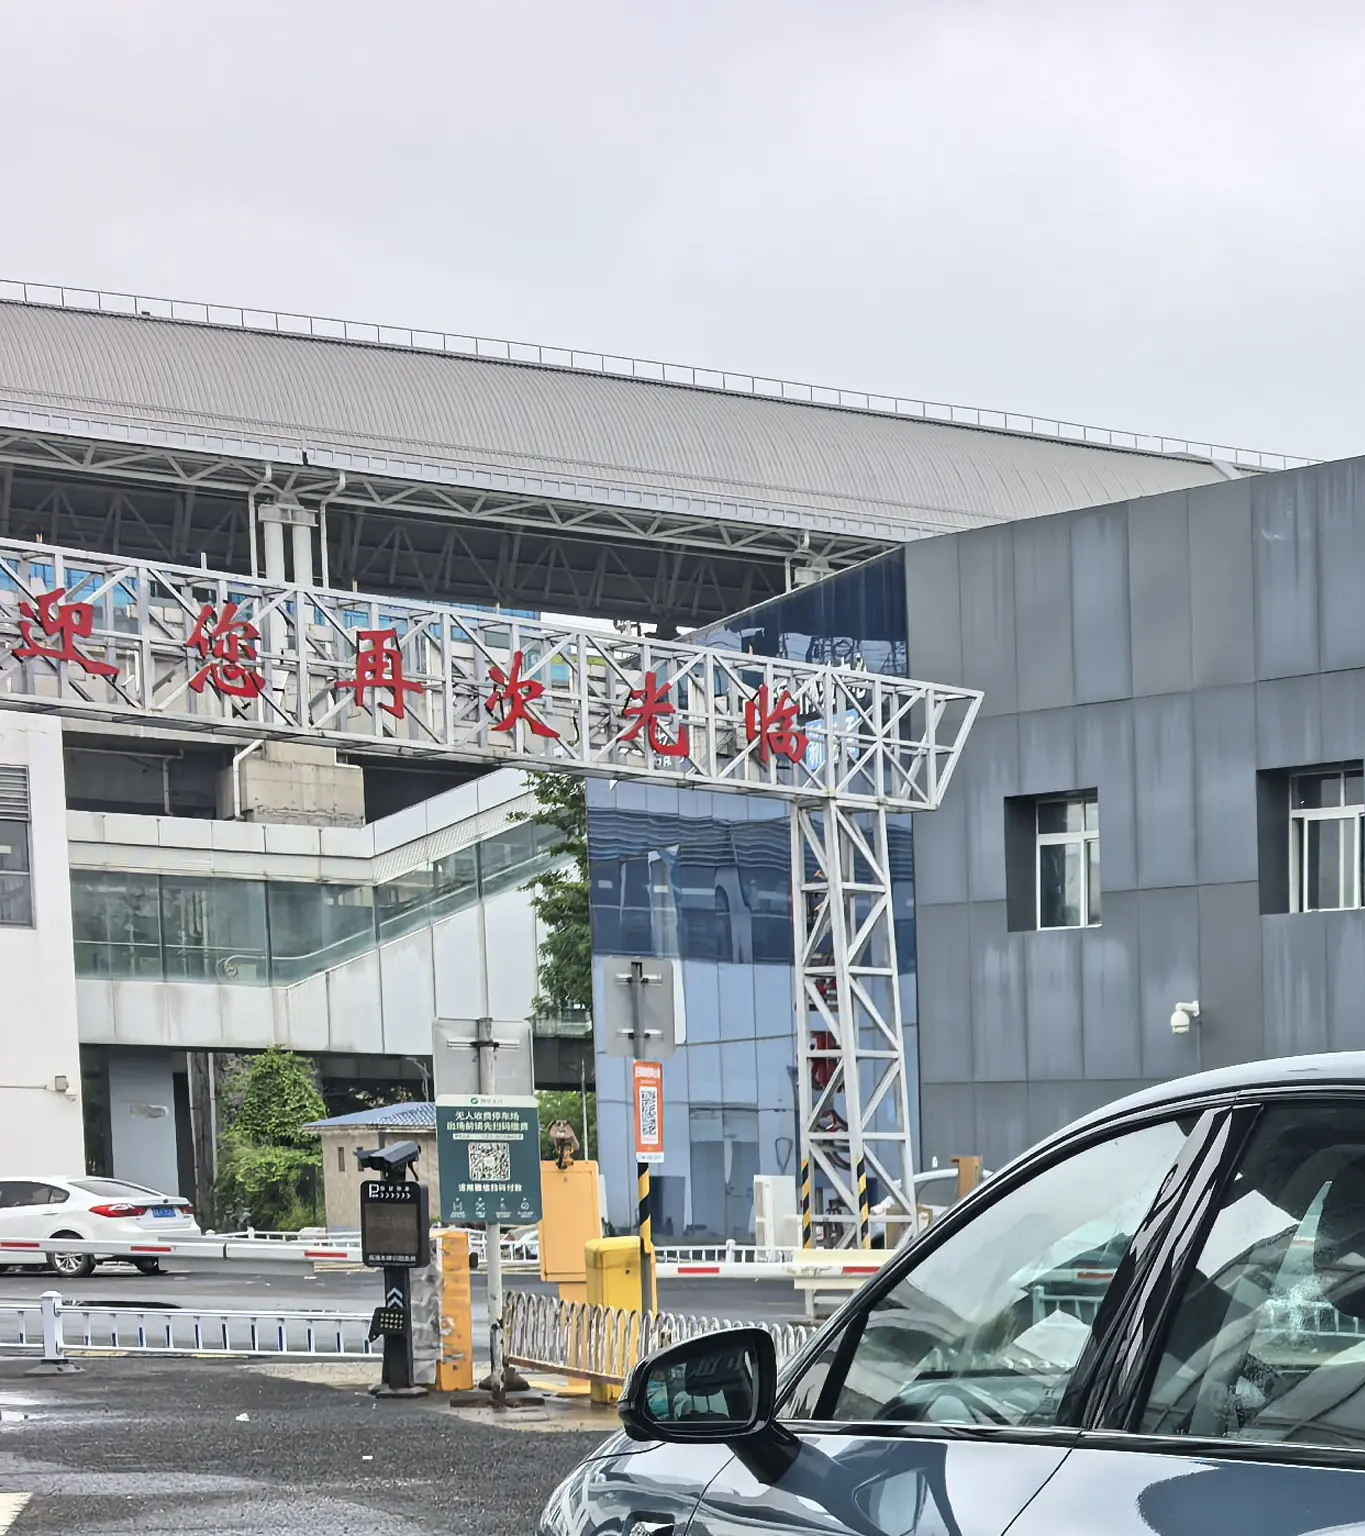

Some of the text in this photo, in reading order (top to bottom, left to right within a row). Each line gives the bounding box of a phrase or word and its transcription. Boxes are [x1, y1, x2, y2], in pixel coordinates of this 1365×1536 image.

[12, 587, 810, 764] 迎您再次光临
